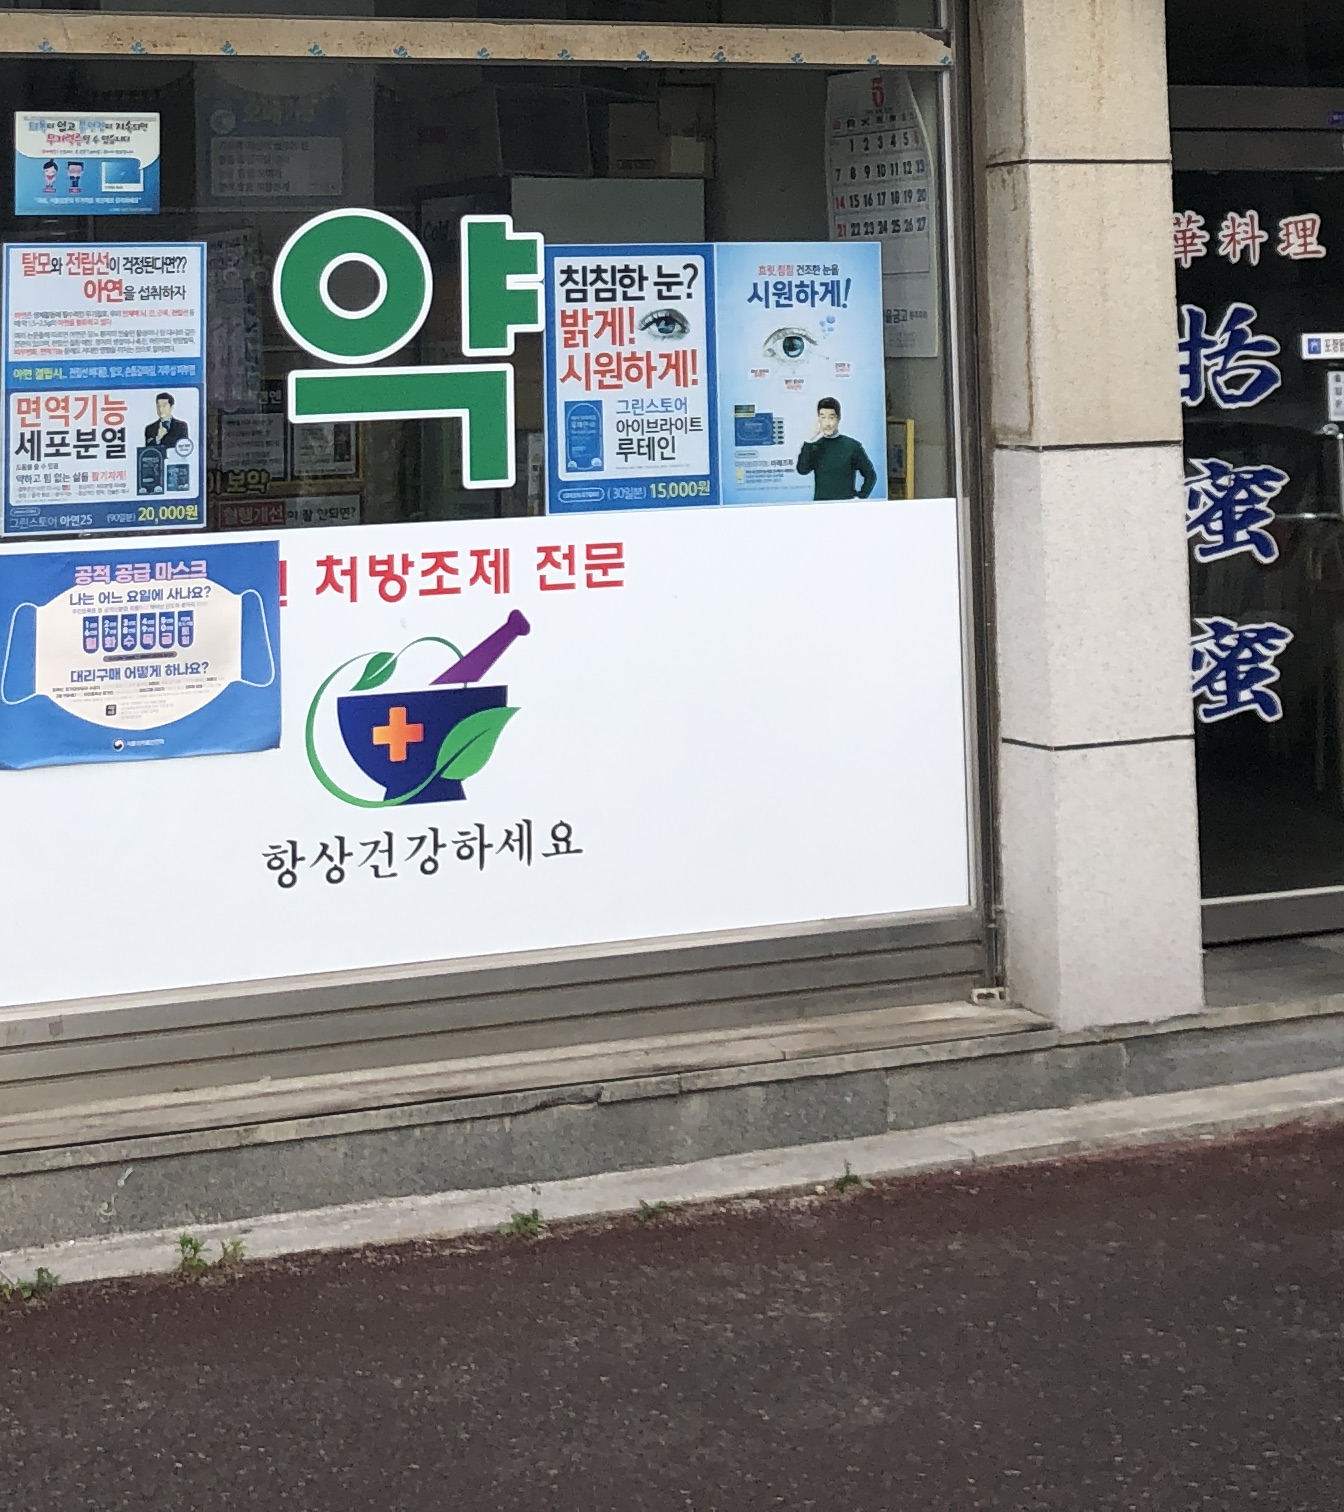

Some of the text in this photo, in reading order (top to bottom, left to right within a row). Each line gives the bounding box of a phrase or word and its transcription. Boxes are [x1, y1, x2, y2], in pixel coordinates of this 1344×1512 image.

[871, 76, 884, 108] 5
[863, 137, 870, 151] 2
[877, 135, 884, 149] 3
[890, 133, 897, 147] 4
[903, 132, 909, 146] 5
[835, 159, 925, 182] 7 8 9 10 11 12 13
[835, 188, 926, 209] 14 15 16 17 18 19 20
[837, 216, 926, 237] 21 22 23 24 25 26 27
[22, 251, 187, 277] 탈모와 전립선이 걱정된다면??
[796, 264, 821, 276] 건조한
[822, 264, 839, 276] 눈을
[83, 279, 186, 303] 아연을 섭취하자
[559, 263, 699, 303] 침침한 눈?
[747, 278, 852, 309] 시원하게!
[560, 306, 636, 349] 밝게!
[273, 208, 545, 489] 약
[560, 349, 699, 391] 시원하게!
[17, 394, 128, 428] 면역기능
[616, 397, 687, 416] 그린스토어
[616, 417, 703, 437] 아이브라이트
[15, 427, 126, 462] 세포분열
[616, 436, 676, 462] 루테인
[54, 472, 71, 483] 없는
[72, 472, 88, 482] 삶을
[649, 480, 710, 499] 15,000원
[10, 517, 57, 529] 그린스토어
[59, 514, 93, 527] 아연25
[138, 504, 198, 524] 20,000원
[317, 506, 356, 521] 안되면?
[75, 560, 208, 585] 공적 공급 마스크
[315, 544, 512, 604] 처방조제
[535, 542, 626, 592] 전문
[70, 586, 211, 606] 나는 어느 요일에 사나요?
[124, 635, 134, 647] 수
[70, 662, 209, 683] 대리구매 어떻게 하나요?
[261, 818, 584, 890] 항상건강하세요
